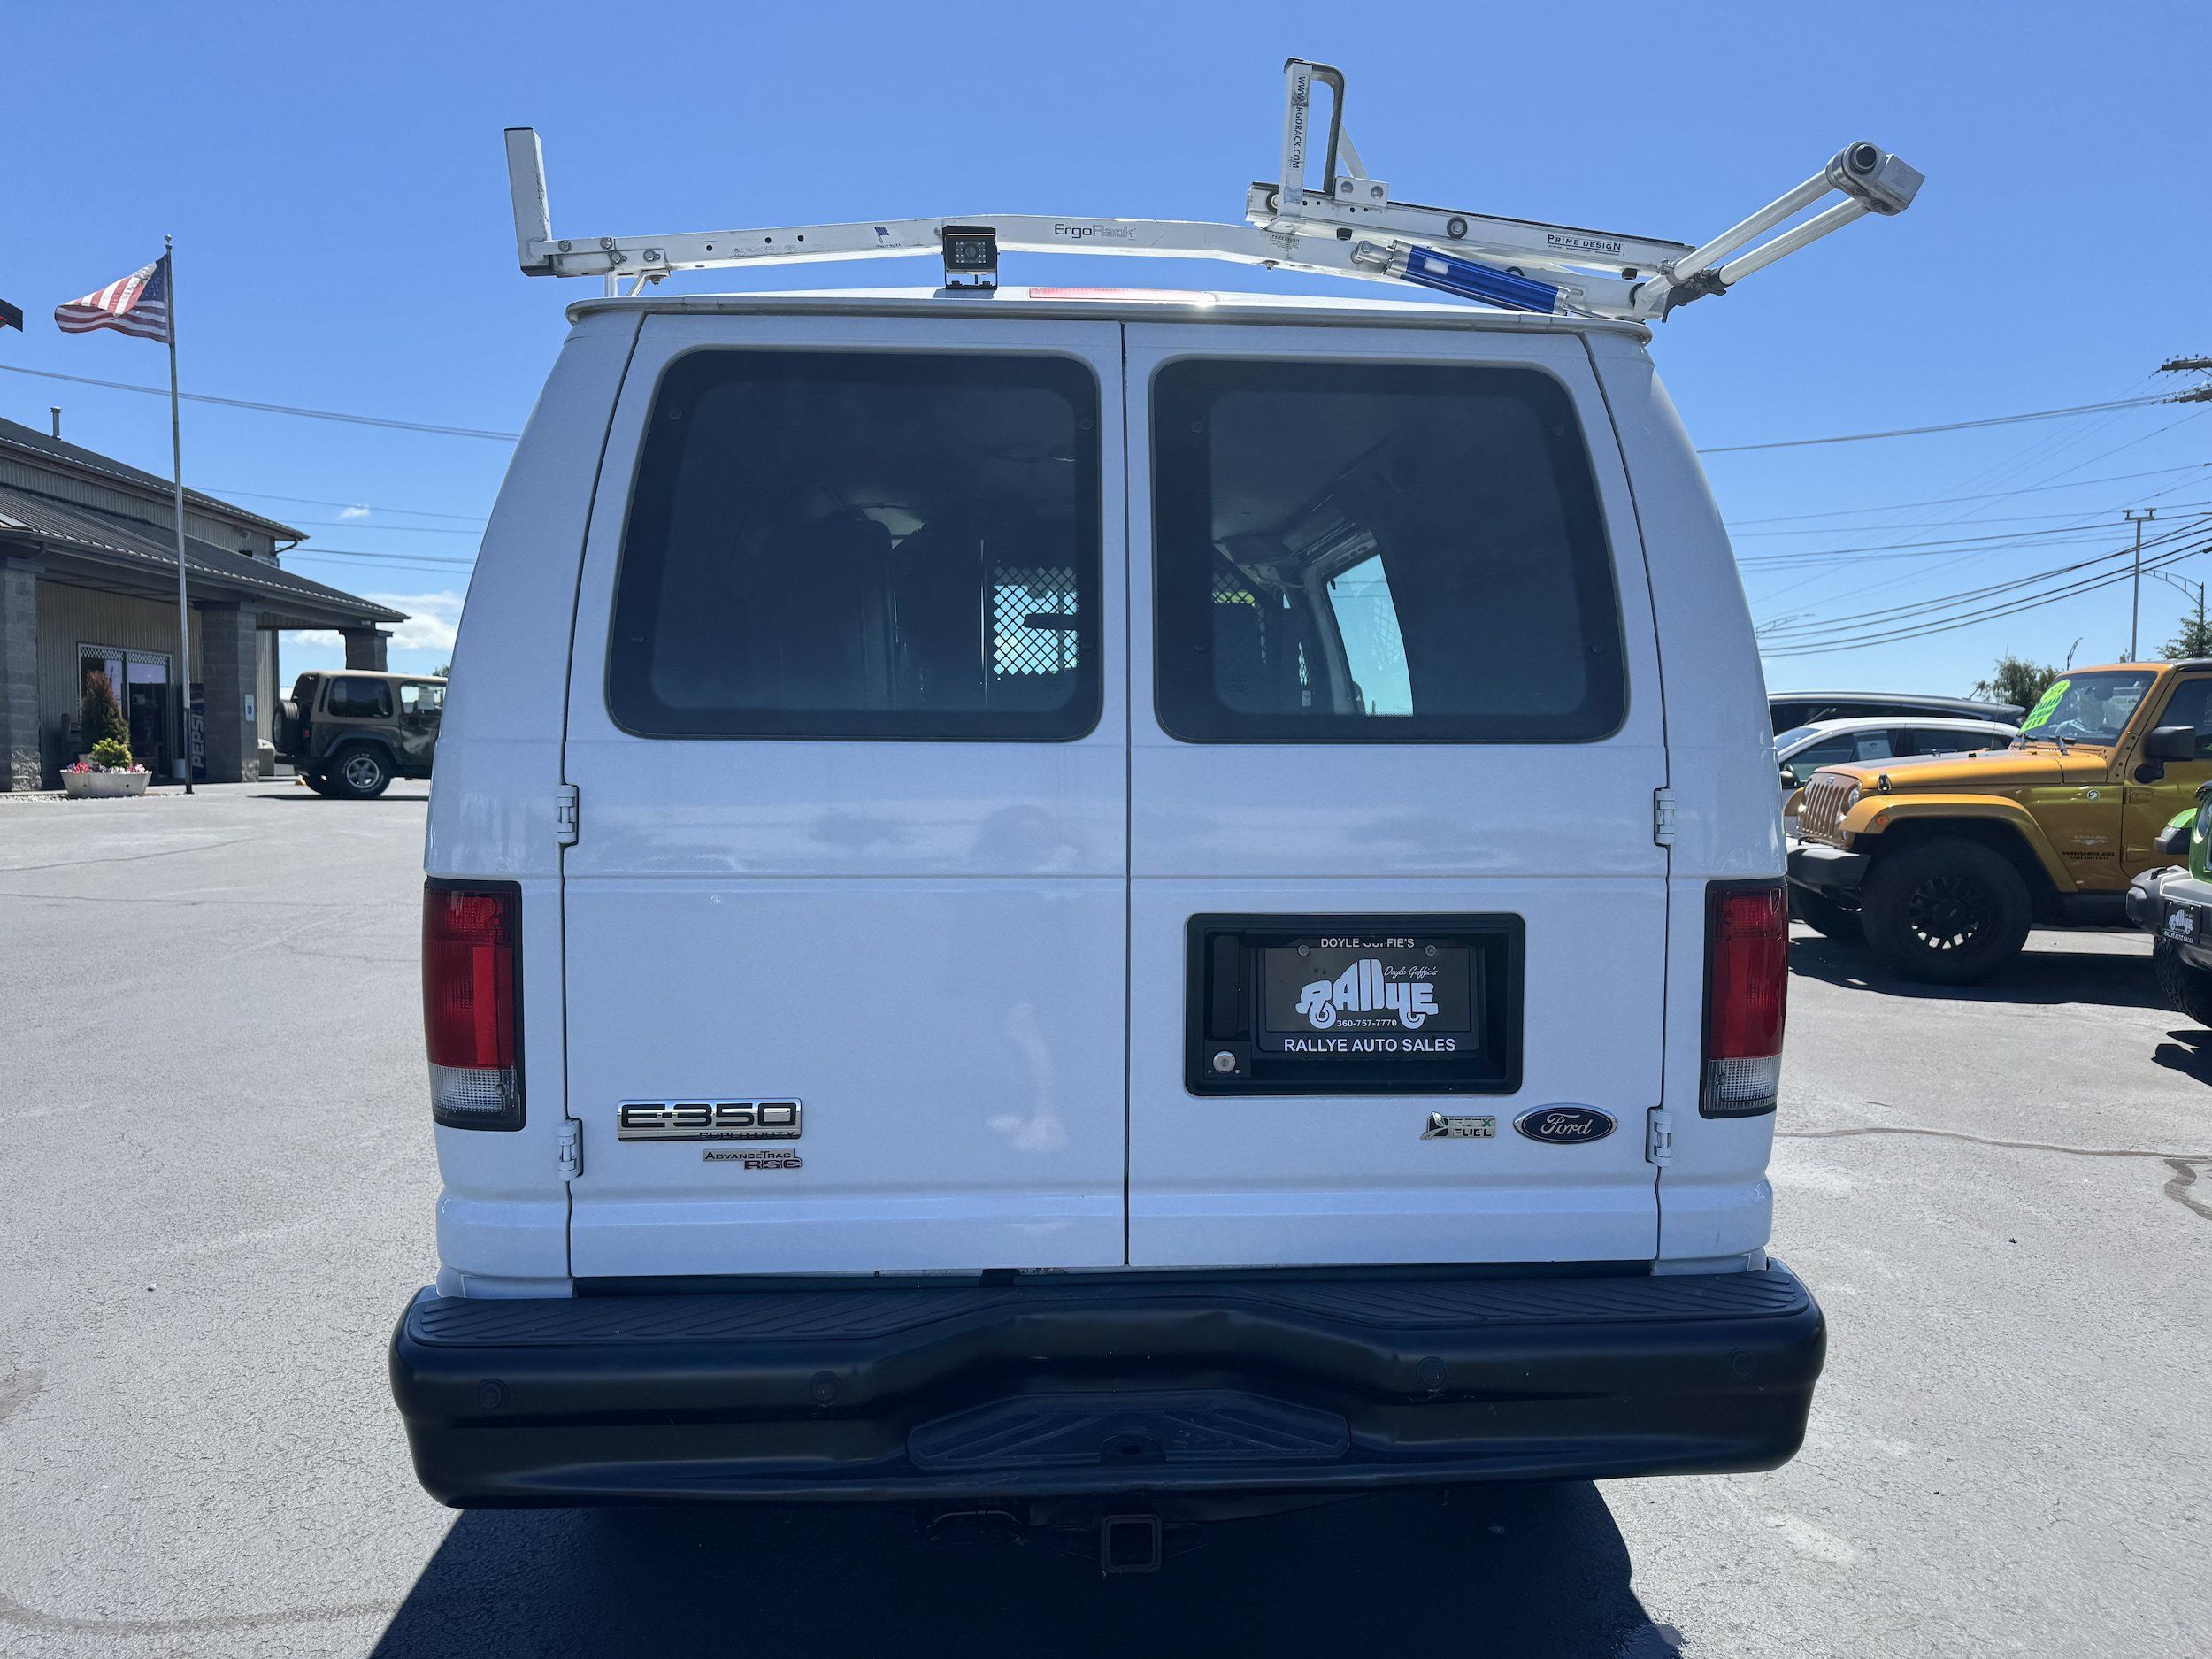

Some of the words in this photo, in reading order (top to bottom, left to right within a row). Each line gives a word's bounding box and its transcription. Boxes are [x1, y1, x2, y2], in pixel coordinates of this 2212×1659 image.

[1292, 76, 1306, 169] WWWRGORACK.COM
[1547, 234, 1579, 246] PRIME
[1583, 240, 1621, 251] DESIGN
[191, 713, 204, 769] PEPSI
[1320, 937, 1360, 948] DOYLE
[1384, 965, 1408, 978] Doyle
[1336, 1018, 1398, 1028] 360-757-7770
[1284, 1038, 1348, 1052] RALLYE
[1351, 1038, 1398, 1053] AUTO
[1402, 1038, 1456, 1052] SALES
[1540, 1112, 1593, 1135] Ford
[699, 1131, 749, 1140] SUPER
[754, 1131, 795, 1140] DUTY
[1453, 1128, 1492, 1137] FUEL
